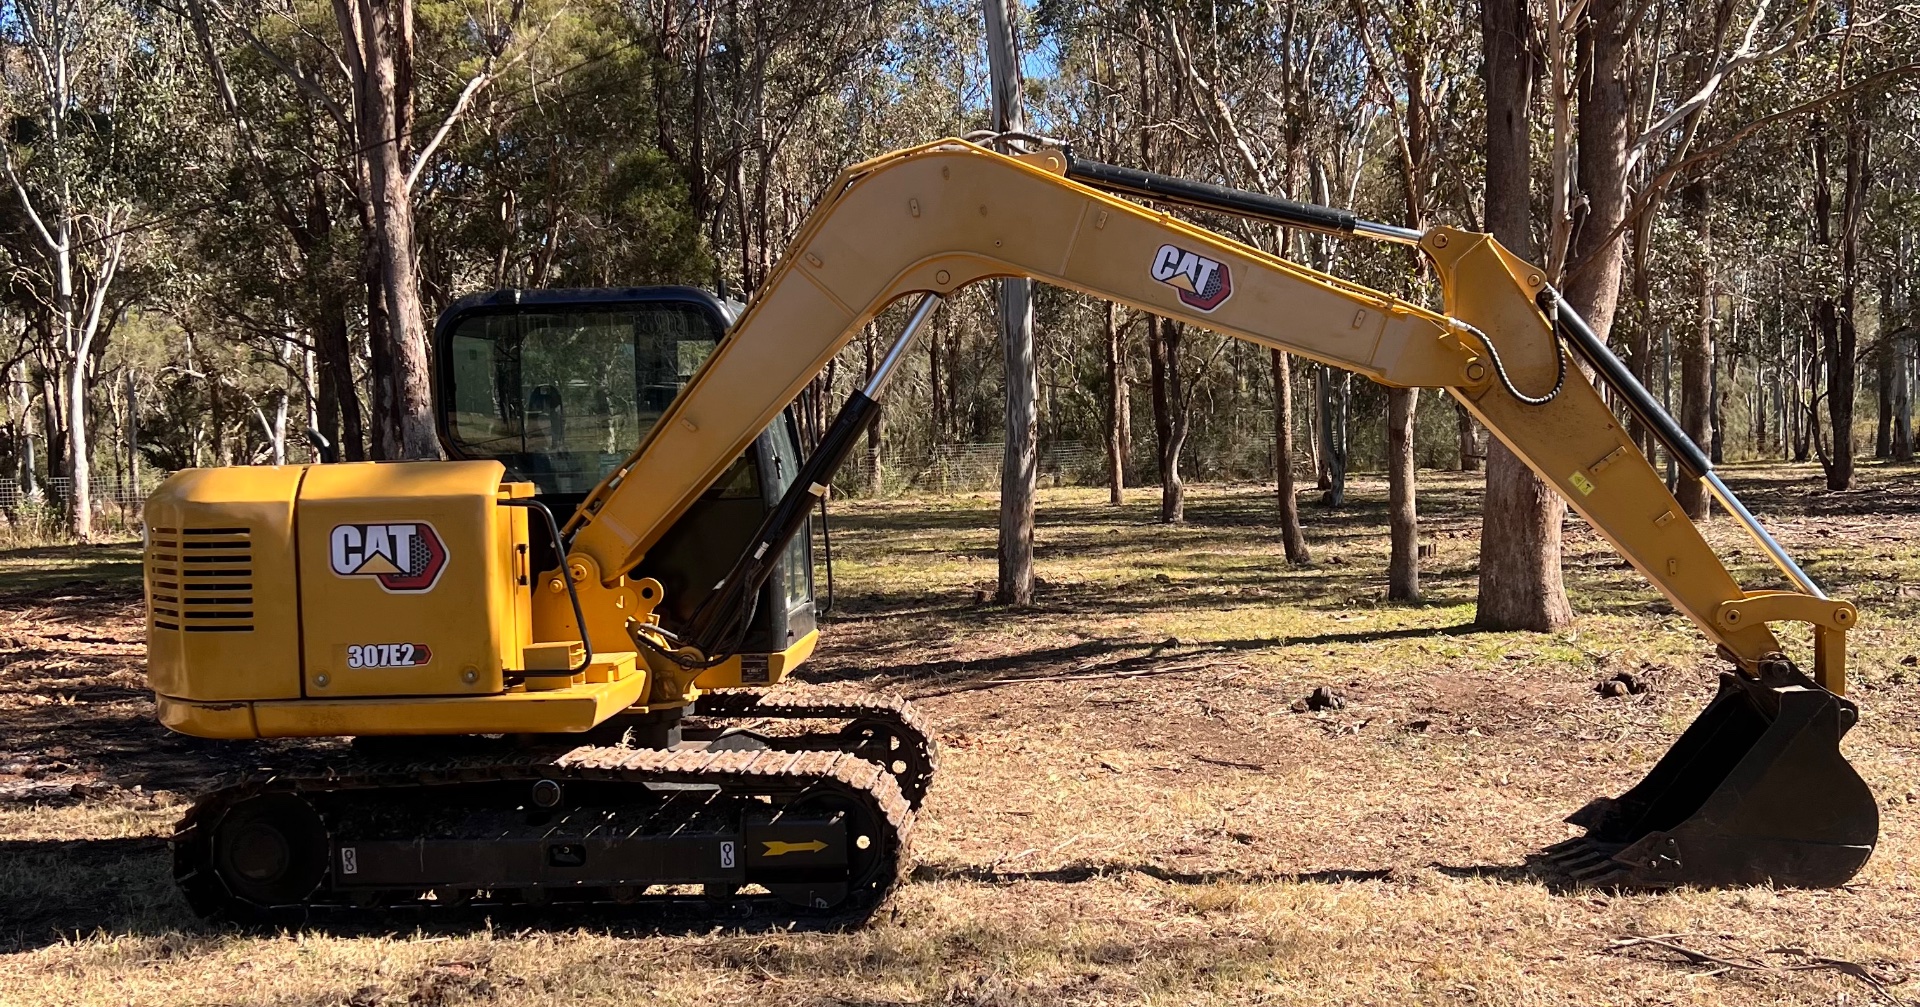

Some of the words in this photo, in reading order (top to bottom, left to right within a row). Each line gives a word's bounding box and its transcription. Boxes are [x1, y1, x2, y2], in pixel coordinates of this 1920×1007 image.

[1151, 244, 1219, 296] CAT
[332, 525, 416, 573] CAT
[348, 643, 415, 667] 307E2
